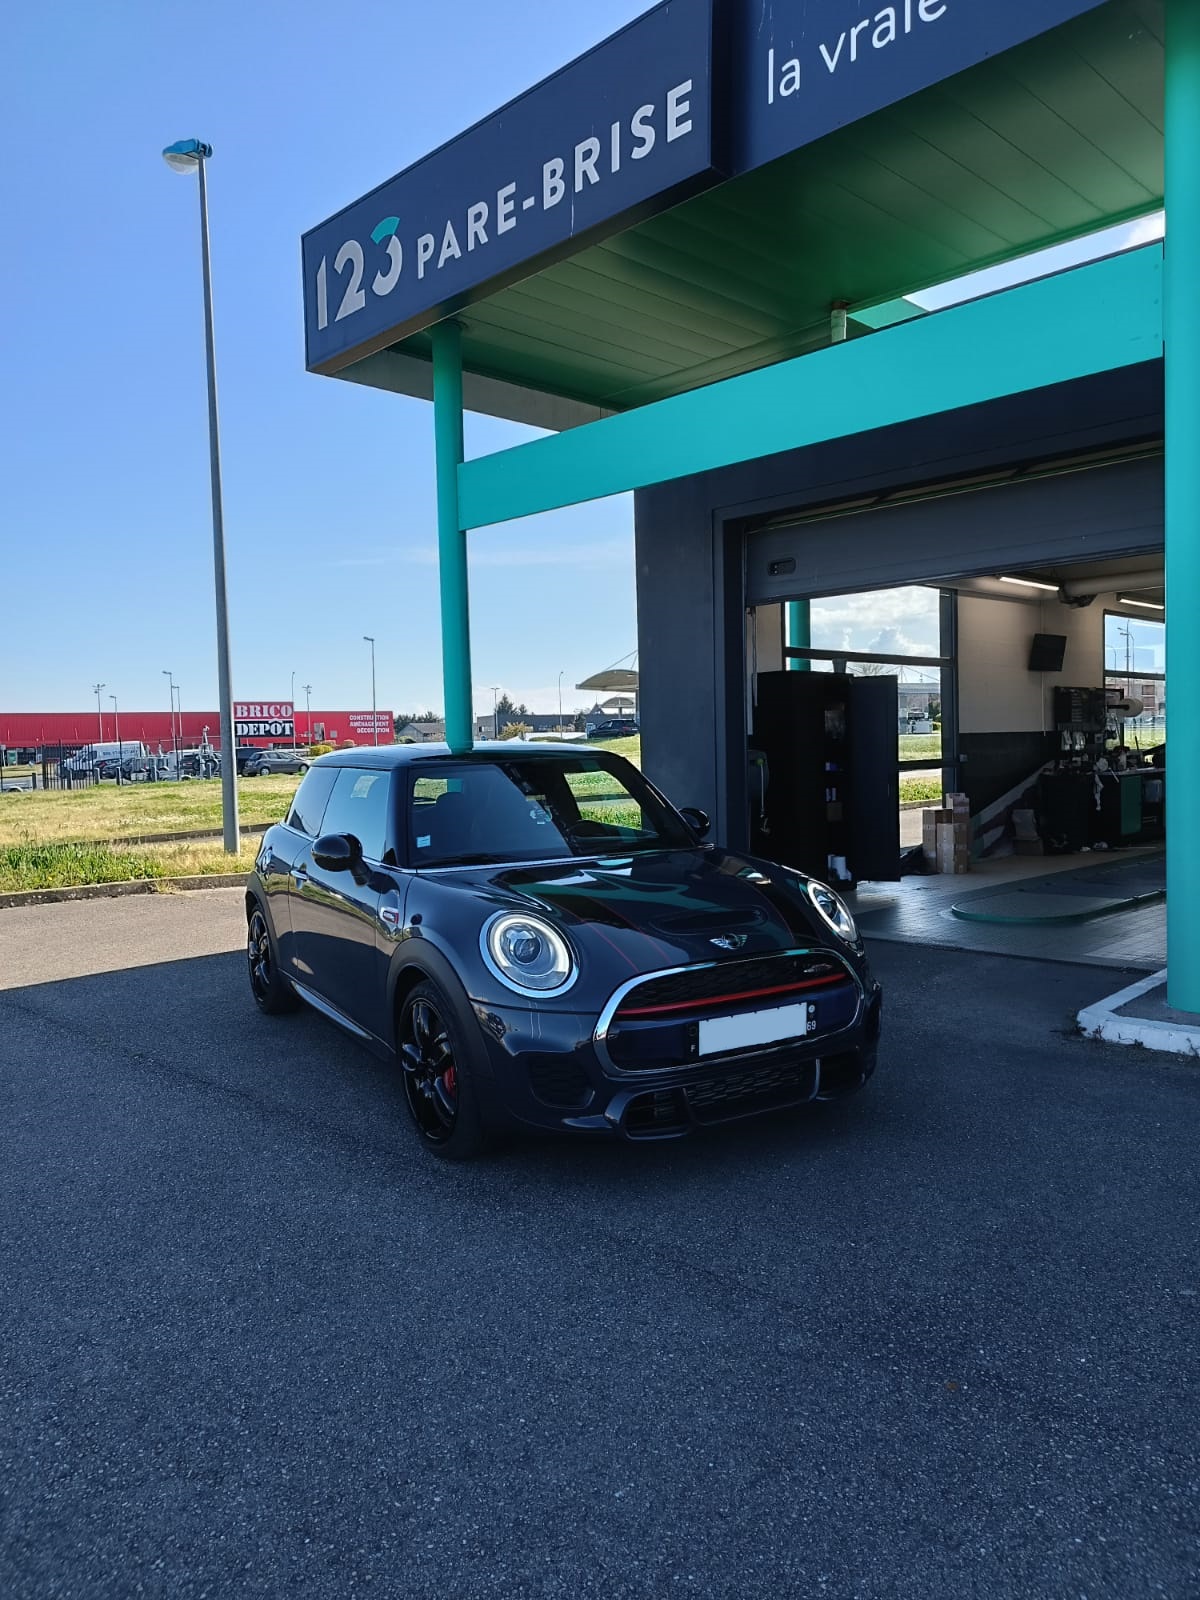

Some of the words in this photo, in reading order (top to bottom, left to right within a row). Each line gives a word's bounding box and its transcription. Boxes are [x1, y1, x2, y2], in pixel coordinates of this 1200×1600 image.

[767, 48, 801, 104] la
[316, 215, 403, 331] 123
[416, 78, 694, 281] PARE-BRISE
[235, 704, 292, 718] BRICO
[806, 1020, 817, 1031] 69
